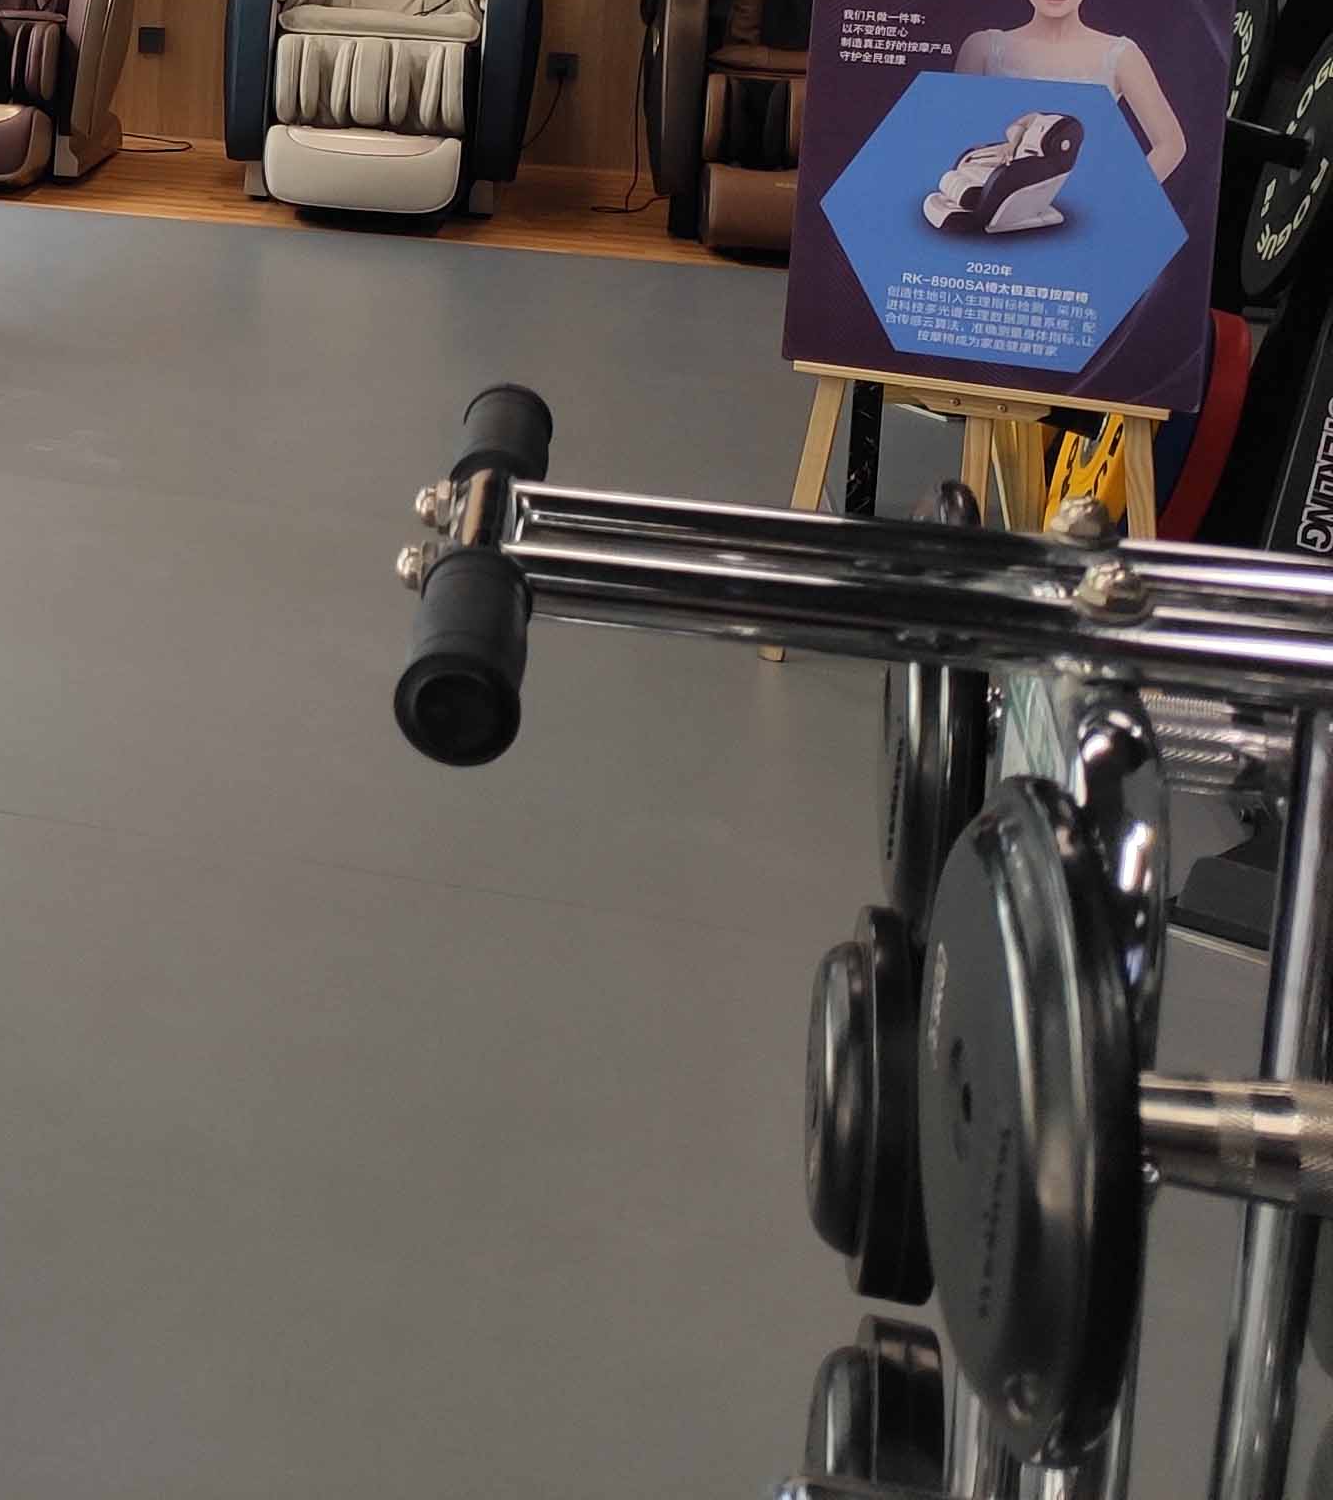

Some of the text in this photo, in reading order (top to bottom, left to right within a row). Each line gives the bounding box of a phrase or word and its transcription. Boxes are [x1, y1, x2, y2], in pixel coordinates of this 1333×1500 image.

[841, 22, 909, 38] 以不变的匠心
[839, 36, 953, 55] 制造真正好的按摩产品
[838, 50, 907, 66] 守护全民健康
[966, 261, 1014, 277] 2020年
